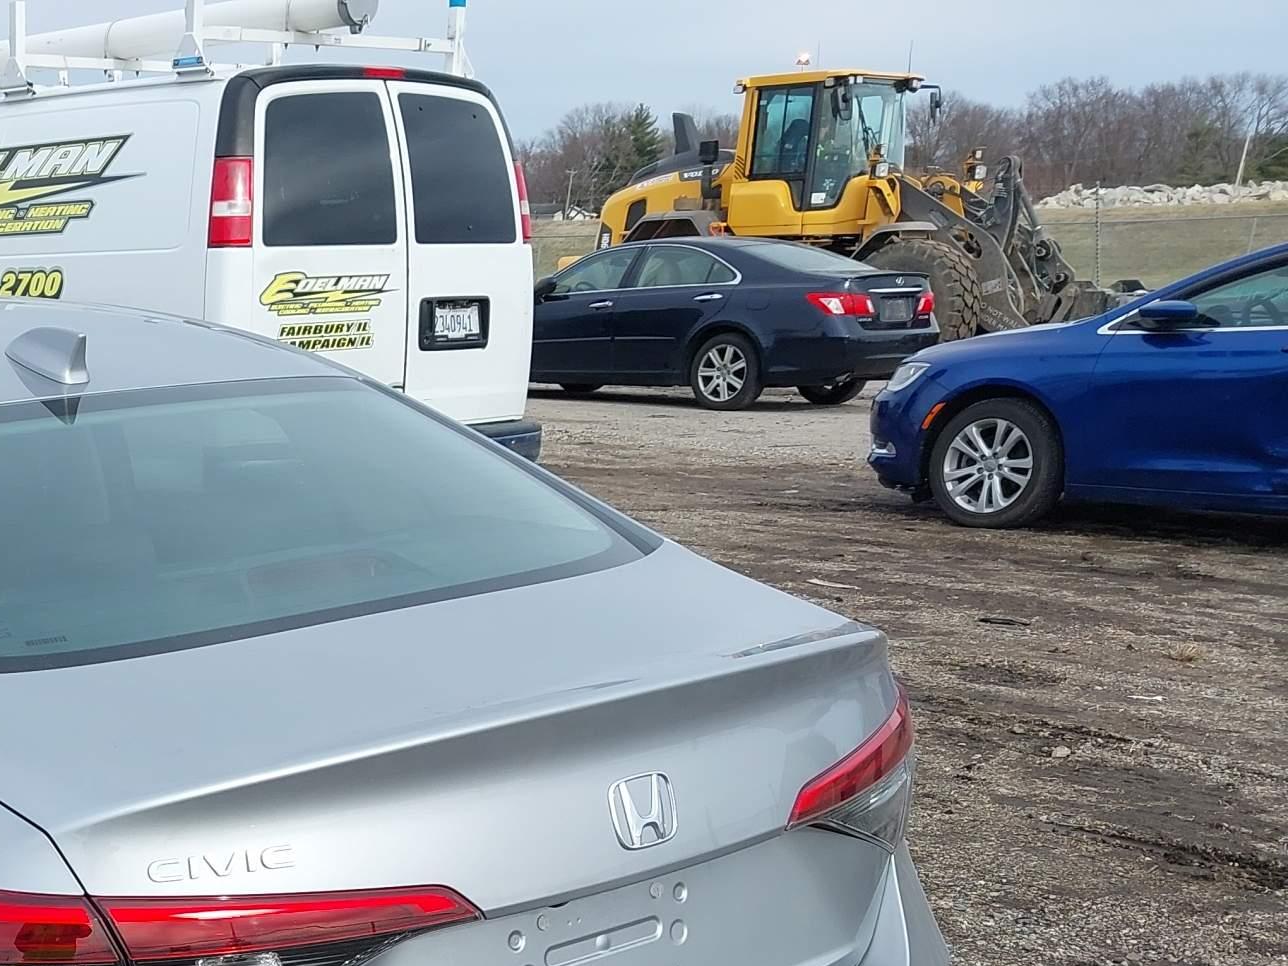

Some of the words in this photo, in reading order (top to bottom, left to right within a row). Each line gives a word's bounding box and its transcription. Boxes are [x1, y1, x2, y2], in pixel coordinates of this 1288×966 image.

[683, 168, 720, 179] VOLO
[29, 203, 89, 218] HEATING
[259, 272, 390, 305] EDELMAN
[279, 322, 354, 337] FAIRBURY
[356, 321, 369, 332] IL
[360, 335, 372, 346] IL
[147, 844, 296, 884] CIVIC
